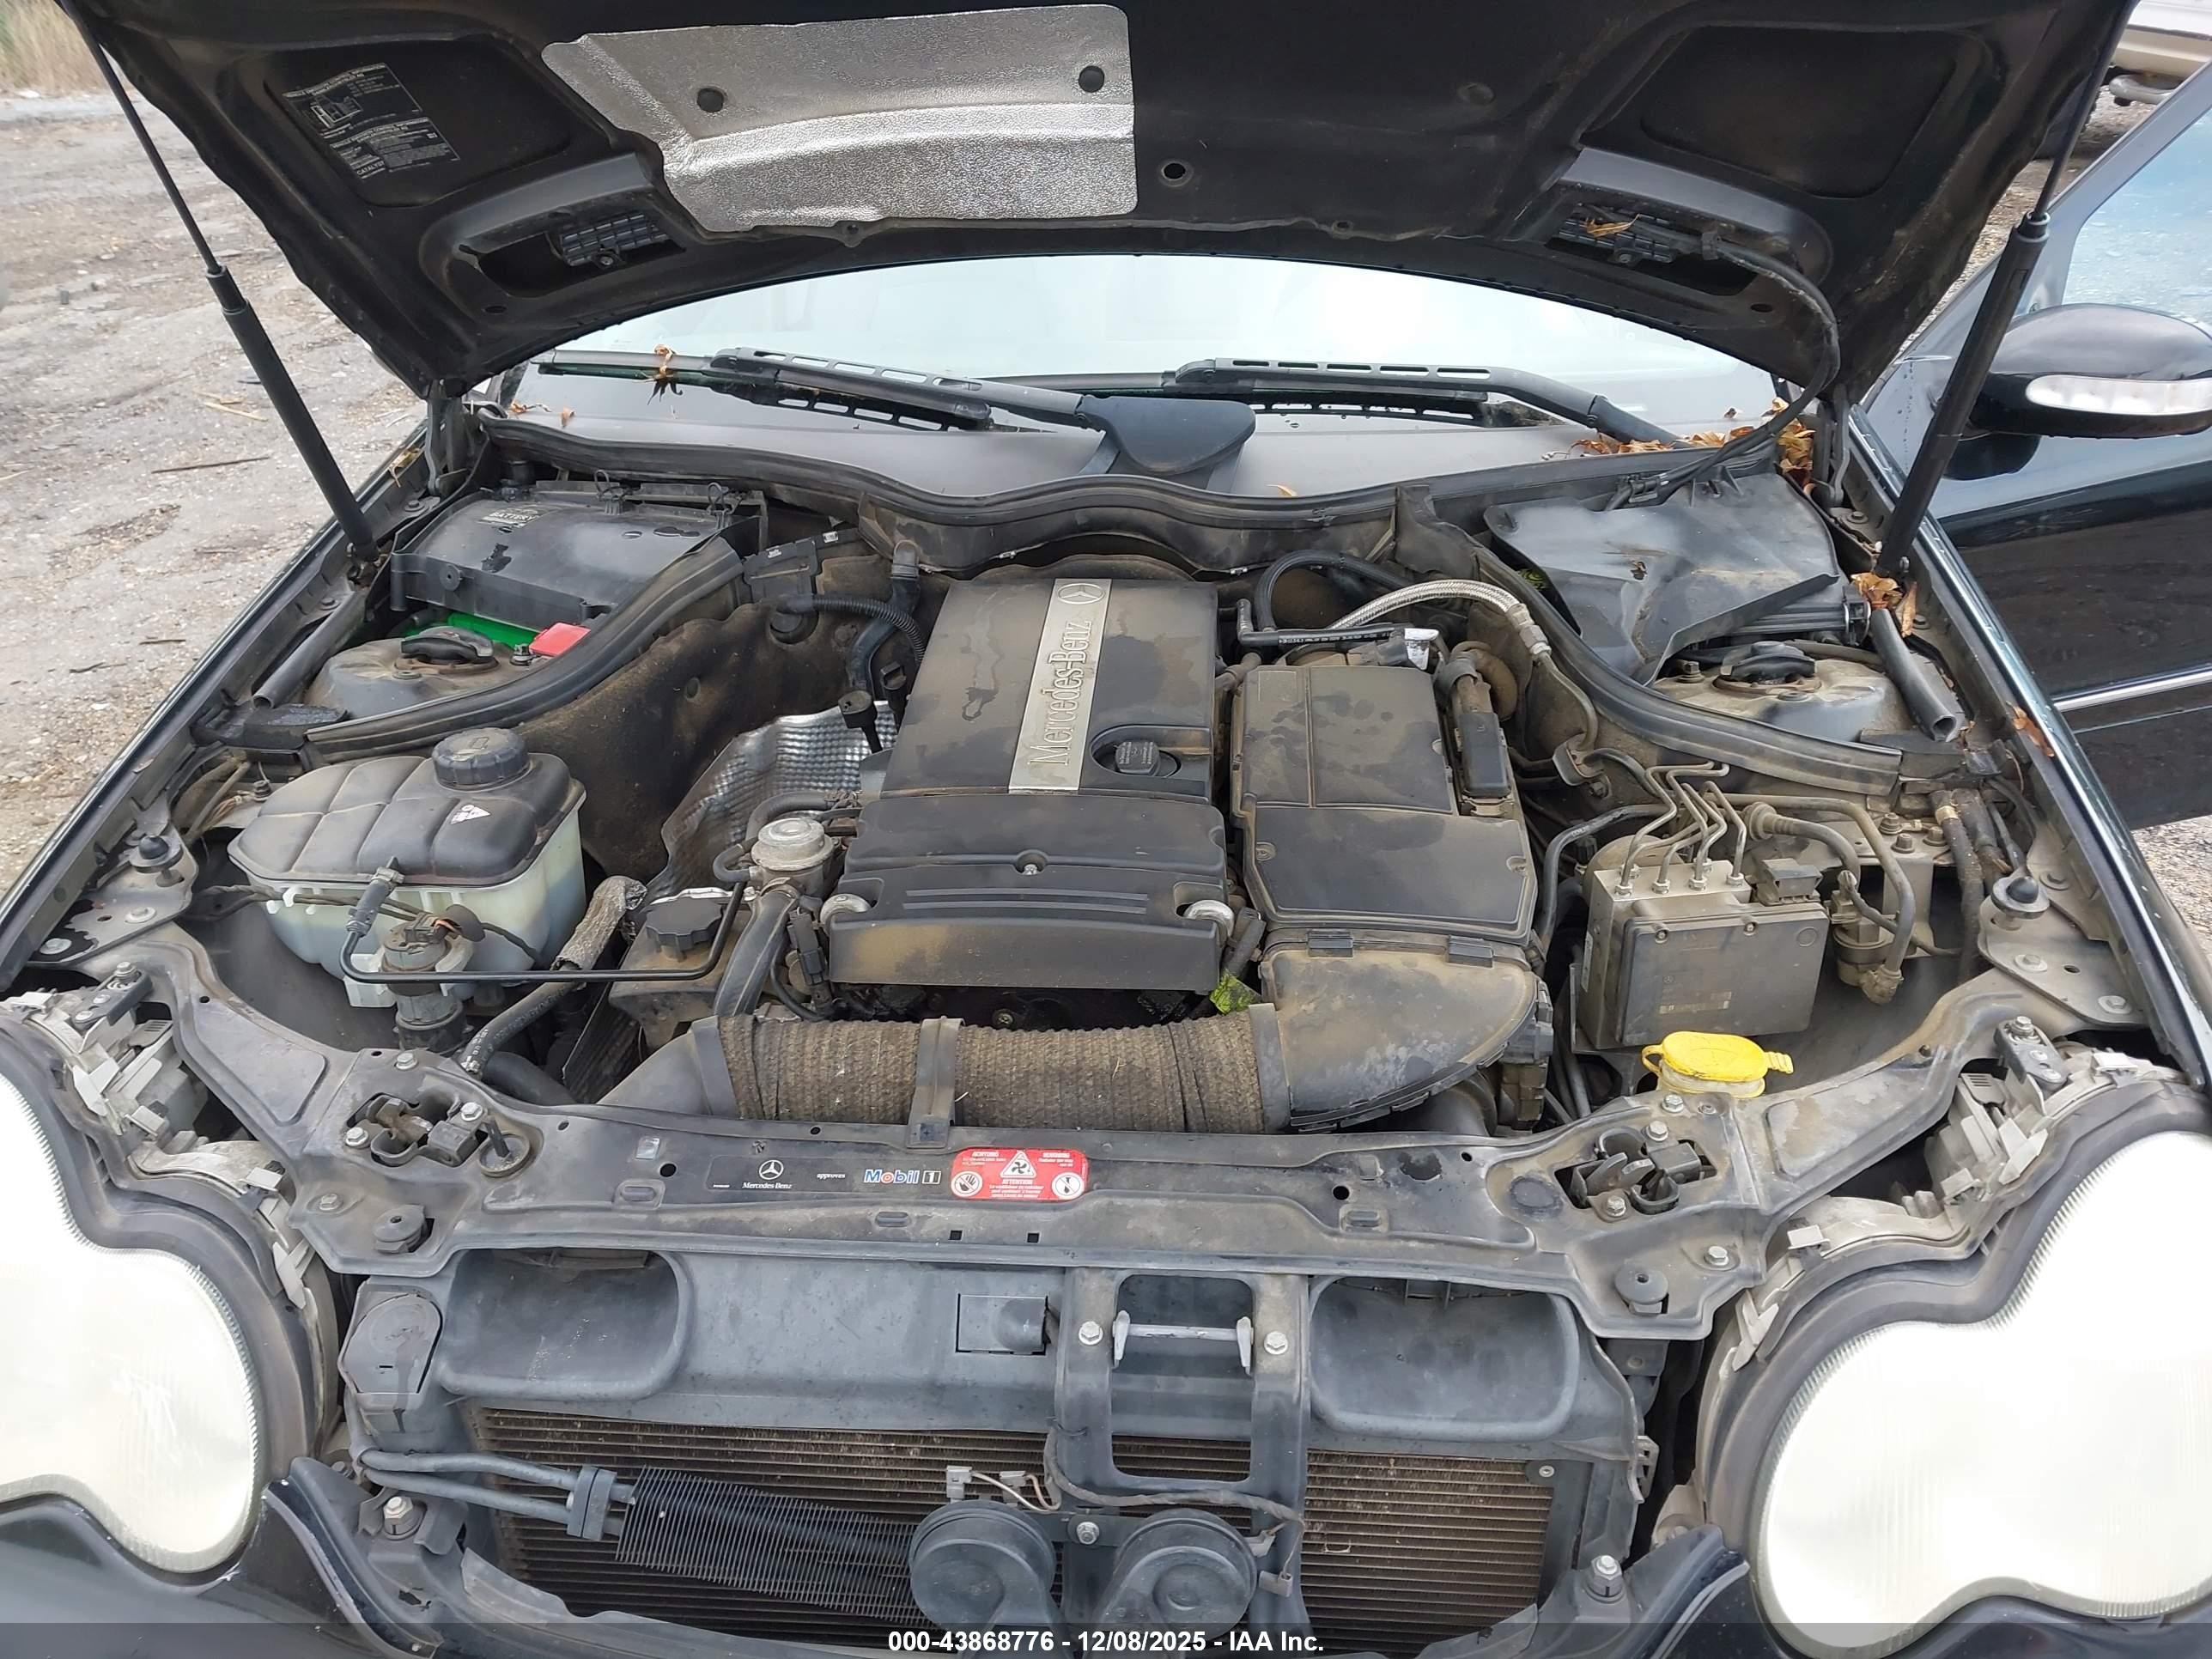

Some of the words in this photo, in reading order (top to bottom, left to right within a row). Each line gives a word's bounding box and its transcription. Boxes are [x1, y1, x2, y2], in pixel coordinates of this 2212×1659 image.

[1027, 621, 1092, 766] Mercedes-Benz
[864, 1169, 920, 1184] Mobil
[925, 1170, 939, 1183] 1
